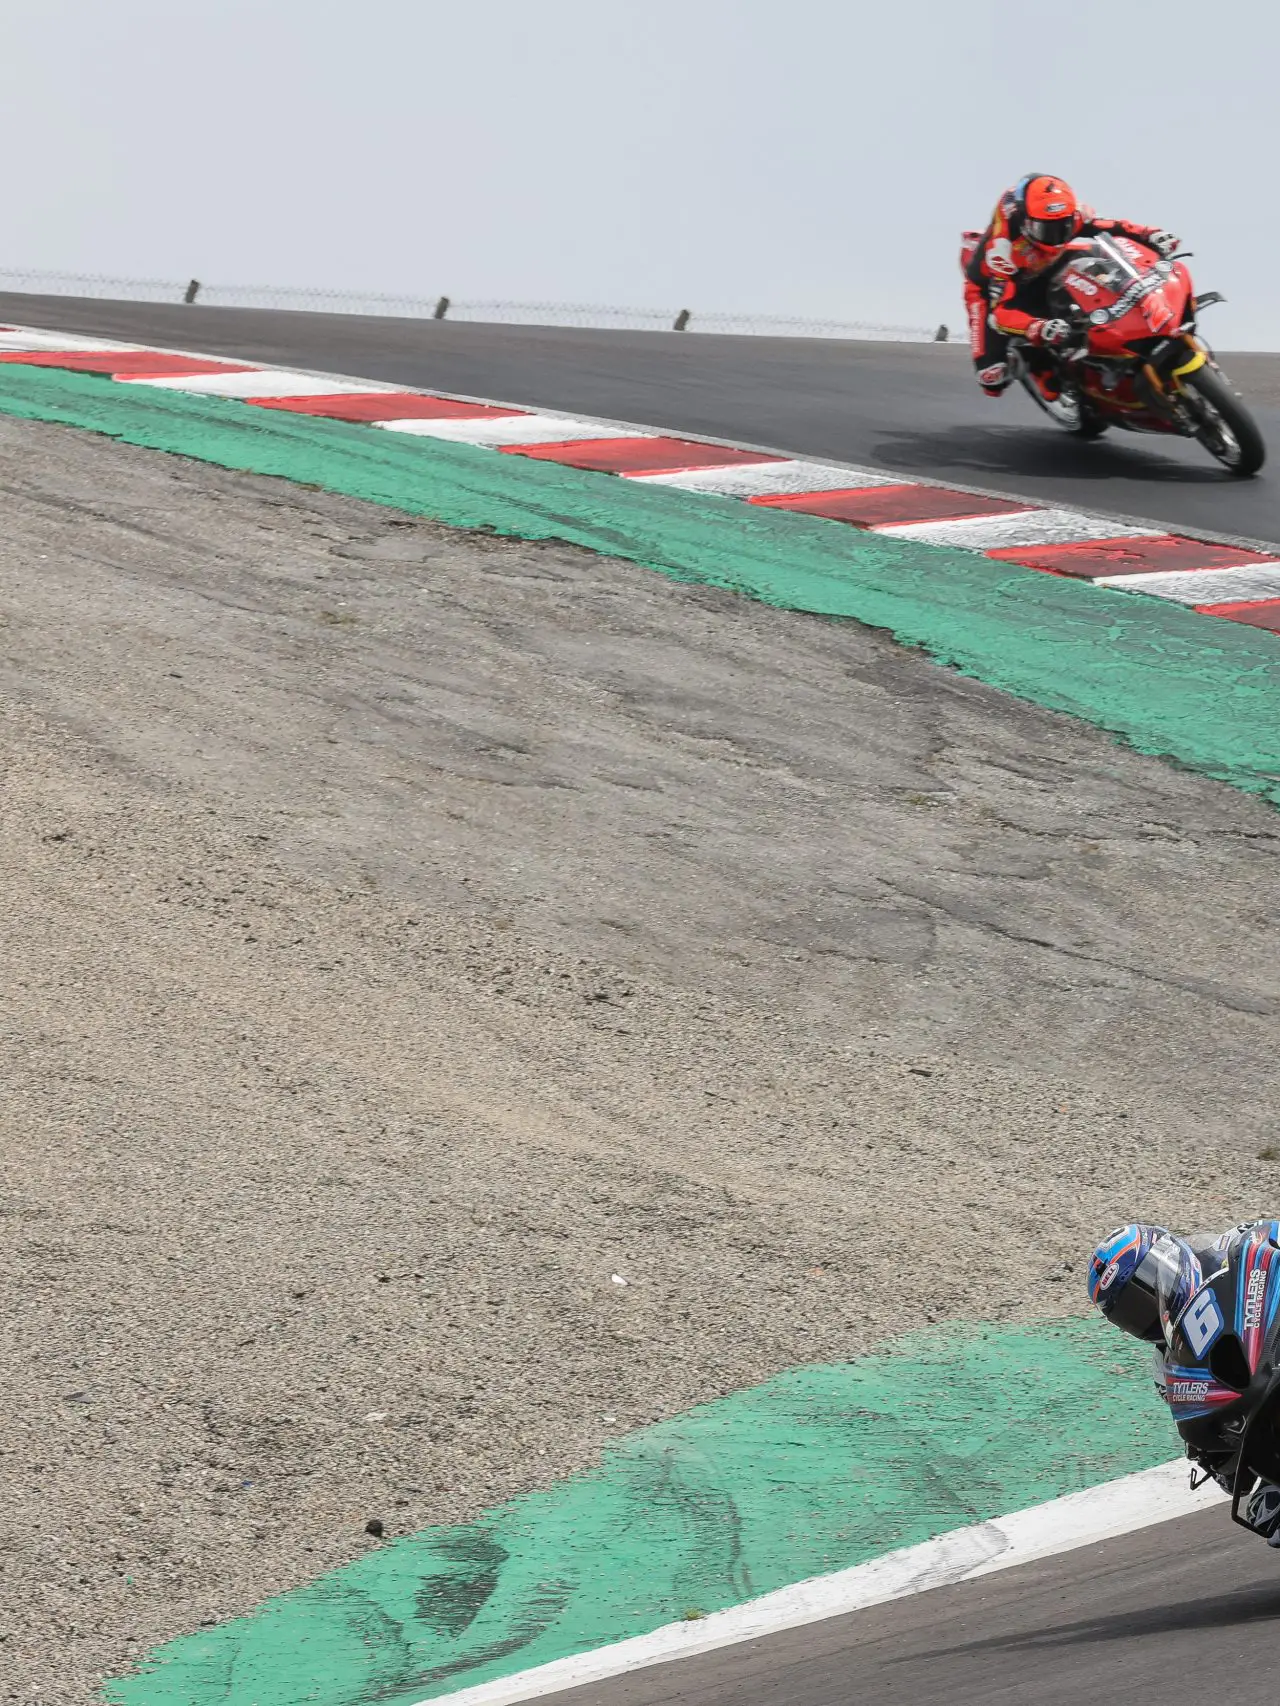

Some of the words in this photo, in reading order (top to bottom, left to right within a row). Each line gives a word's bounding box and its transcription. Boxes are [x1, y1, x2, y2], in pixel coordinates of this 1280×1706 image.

[1101, 1267, 1116, 1286] BELL
[1257, 1270, 1267, 1300] RACING
[1244, 1269, 1260, 1330] TYTLERS
[1182, 1288, 1223, 1360] 6
[1254, 1301, 1262, 1329] CYCLE
[1172, 1394, 1186, 1402] CYCLE
[1186, 1394, 1205, 1402] RACING
[1173, 1382, 1209, 1394] TYTLERS
